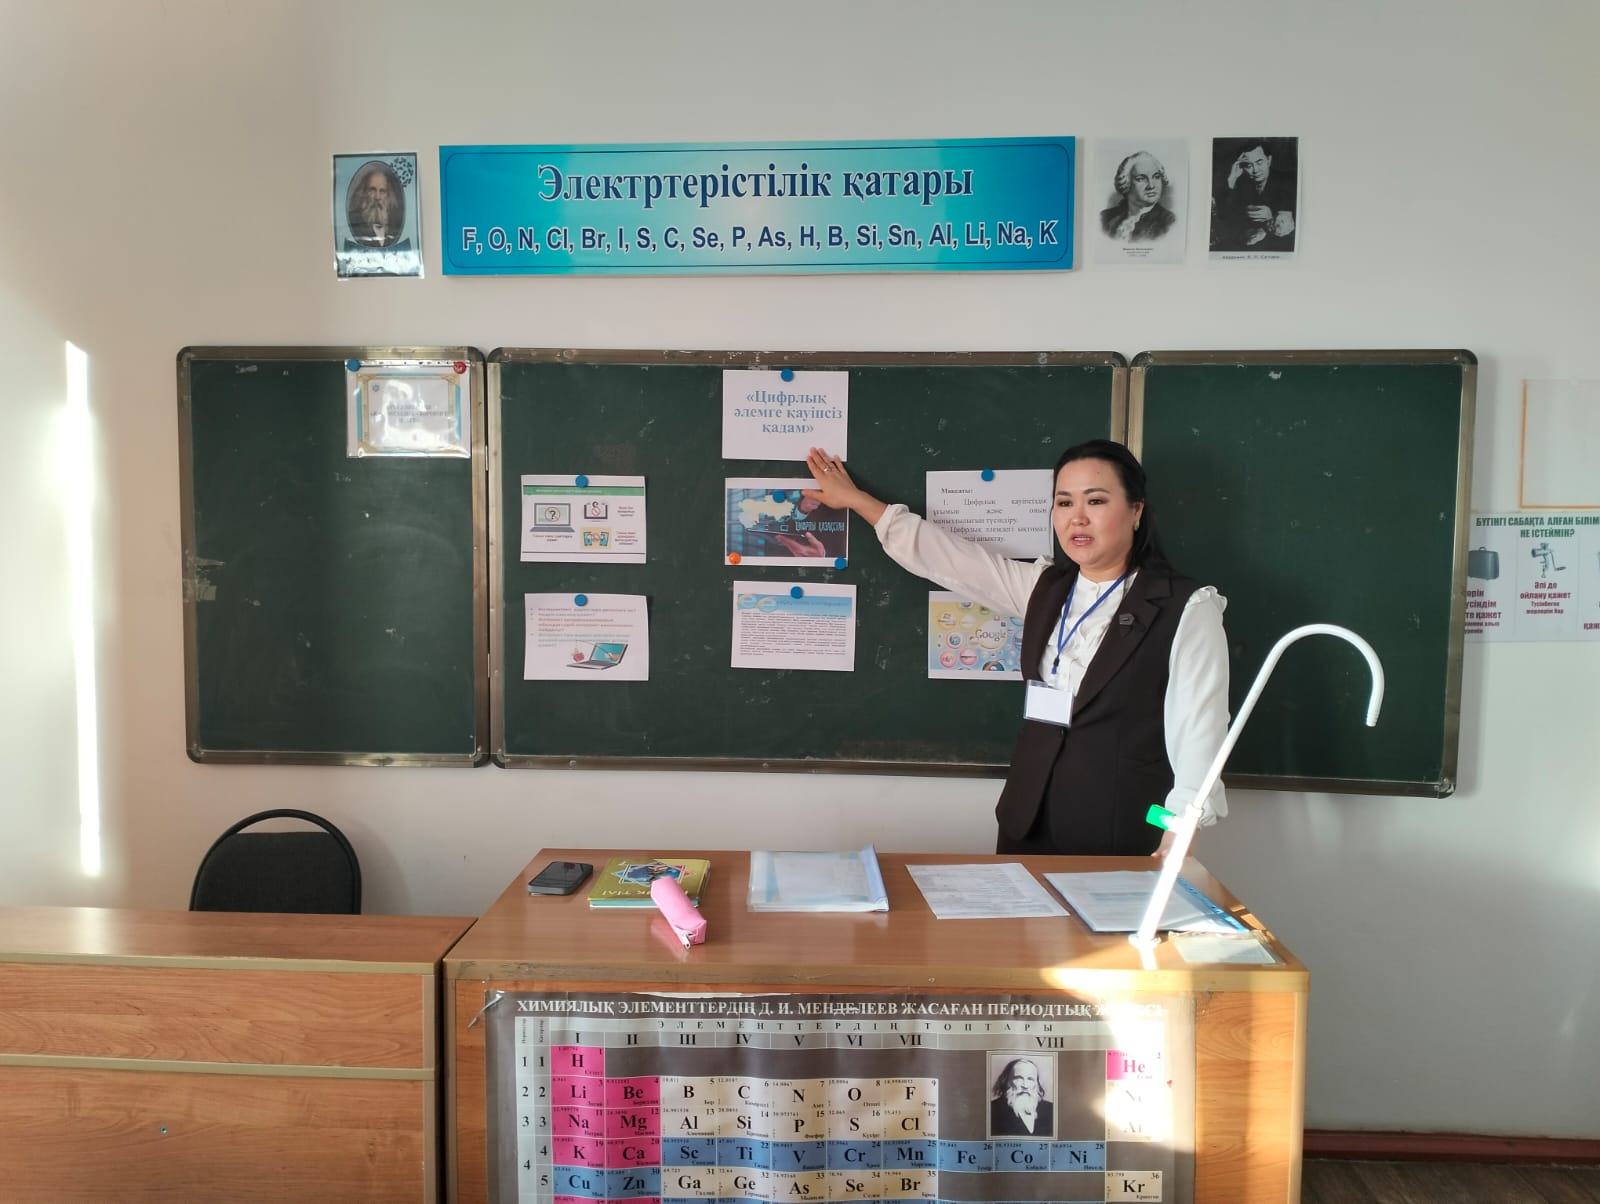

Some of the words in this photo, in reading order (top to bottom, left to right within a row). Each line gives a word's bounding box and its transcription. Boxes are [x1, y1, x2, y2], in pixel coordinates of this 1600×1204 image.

[538, 162, 832, 209] Электртерістілік
[842, 168, 974, 207] қатары
[462, 226, 483, 255] F,
[488, 226, 512, 255] O,
[518, 226, 540, 254] N,
[547, 226, 574, 254] Cl,
[581, 226, 611, 254] Br,
[618, 226, 630, 254] I,
[635, 226, 657, 253] S,
[663, 226, 685, 252] C,
[692, 226, 724, 252] Se,
[731, 225, 752, 252] P,
[757, 225, 792, 251] As,
[799, 225, 821, 251] H,
[828, 224, 849, 250] B,
[856, 223, 883, 249] Si,
[888, 223, 922, 249] Sn,
[929, 222, 958, 249] Al,
[964, 222, 991, 249] Li,
[997, 221, 1032, 249] Na,
[1039, 220, 1059, 245] K
[746, 390, 828, 407] «Цифрлық
[734, 407, 783, 418] әлемге
[786, 406, 843, 422] қауіпсіз
[1476, 517, 1507, 527] БҮГІНГІ
[1508, 517, 1545, 528] САБАҚТА
[1547, 516, 1574, 526] АЛҒАН
[1520, 529, 1530, 538] НЕ
[517, 1000, 614, 1015] ХИМИЯЛЫҚ
[618, 1002, 755, 1017] ЭЛЕМЕНТТЕРДІҢ
[758, 1004, 774, 1017] Д.
[778, 1003, 794, 1015] И.
[900, 1003, 983, 1016] ЖАСАҒАН
[988, 1003, 1092, 1018] ПЕРИОДТЫҚ
[626, 1033, 639, 1046] II
[679, 1033, 697, 1046] III
[736, 1033, 752, 1046] IV
[793, 1035, 805, 1047] V
[846, 1034, 864, 1047] VI
[899, 1034, 922, 1046] VII
[1036, 1036, 1065, 1049] VIII
[522, 1056, 527, 1067] 1
[539, 1056, 545, 1067] 1
[572, 1054, 584, 1068] H
[1123, 1059, 1146, 1073] He
[522, 1086, 529, 1097] 2
[538, 1086, 546, 1098] 2
[570, 1085, 587, 1098] Li
[623, 1086, 644, 1100] Be
[683, 1085, 695, 1099] B
[737, 1085, 751, 1099] C
[792, 1088, 805, 1103] N
[847, 1087, 862, 1101] O
[905, 1086, 917, 1100] F
[816, 1110, 825, 1118] 15
[522, 1115, 530, 1127] 3
[539, 1116, 547, 1127] 3
[568, 1114, 590, 1129] Na
[620, 1115, 647, 1131] Mg
[680, 1115, 699, 1130] Al
[736, 1115, 752, 1130] Si
[794, 1119, 805, 1133] P
[849, 1117, 860, 1132] S
[901, 1117, 920, 1131] Cl
[540, 1145, 548, 1156] 4
[573, 1145, 586, 1160] K
[622, 1146, 645, 1161] Ca
[680, 1145, 700, 1160] Sc
[736, 1146, 753, 1161] Ti
[792, 1150, 806, 1164] V
[844, 1148, 866, 1162] Cr
[897, 1147, 924, 1161] Mn
[957, 1150, 977, 1165] Fe
[1010, 1150, 1033, 1164] Co
[1068, 1150, 1088, 1164] Ni
[983, 1143, 993, 1151] 26
[523, 1159, 531, 1170] 4
[540, 1175, 548, 1186] 5
[568, 1174, 591, 1190] Cu
[623, 1176, 646, 1191] Zn
[678, 1175, 702, 1190] Ga
[733, 1175, 756, 1190] Ge
[789, 1181, 810, 1195] As
[845, 1179, 865, 1192] Se
[901, 1178, 921, 1191] Br
[1122, 1179, 1146, 1193] Kr
[816, 1172, 825, 1180] 33
[927, 1170, 936, 1178] 35
